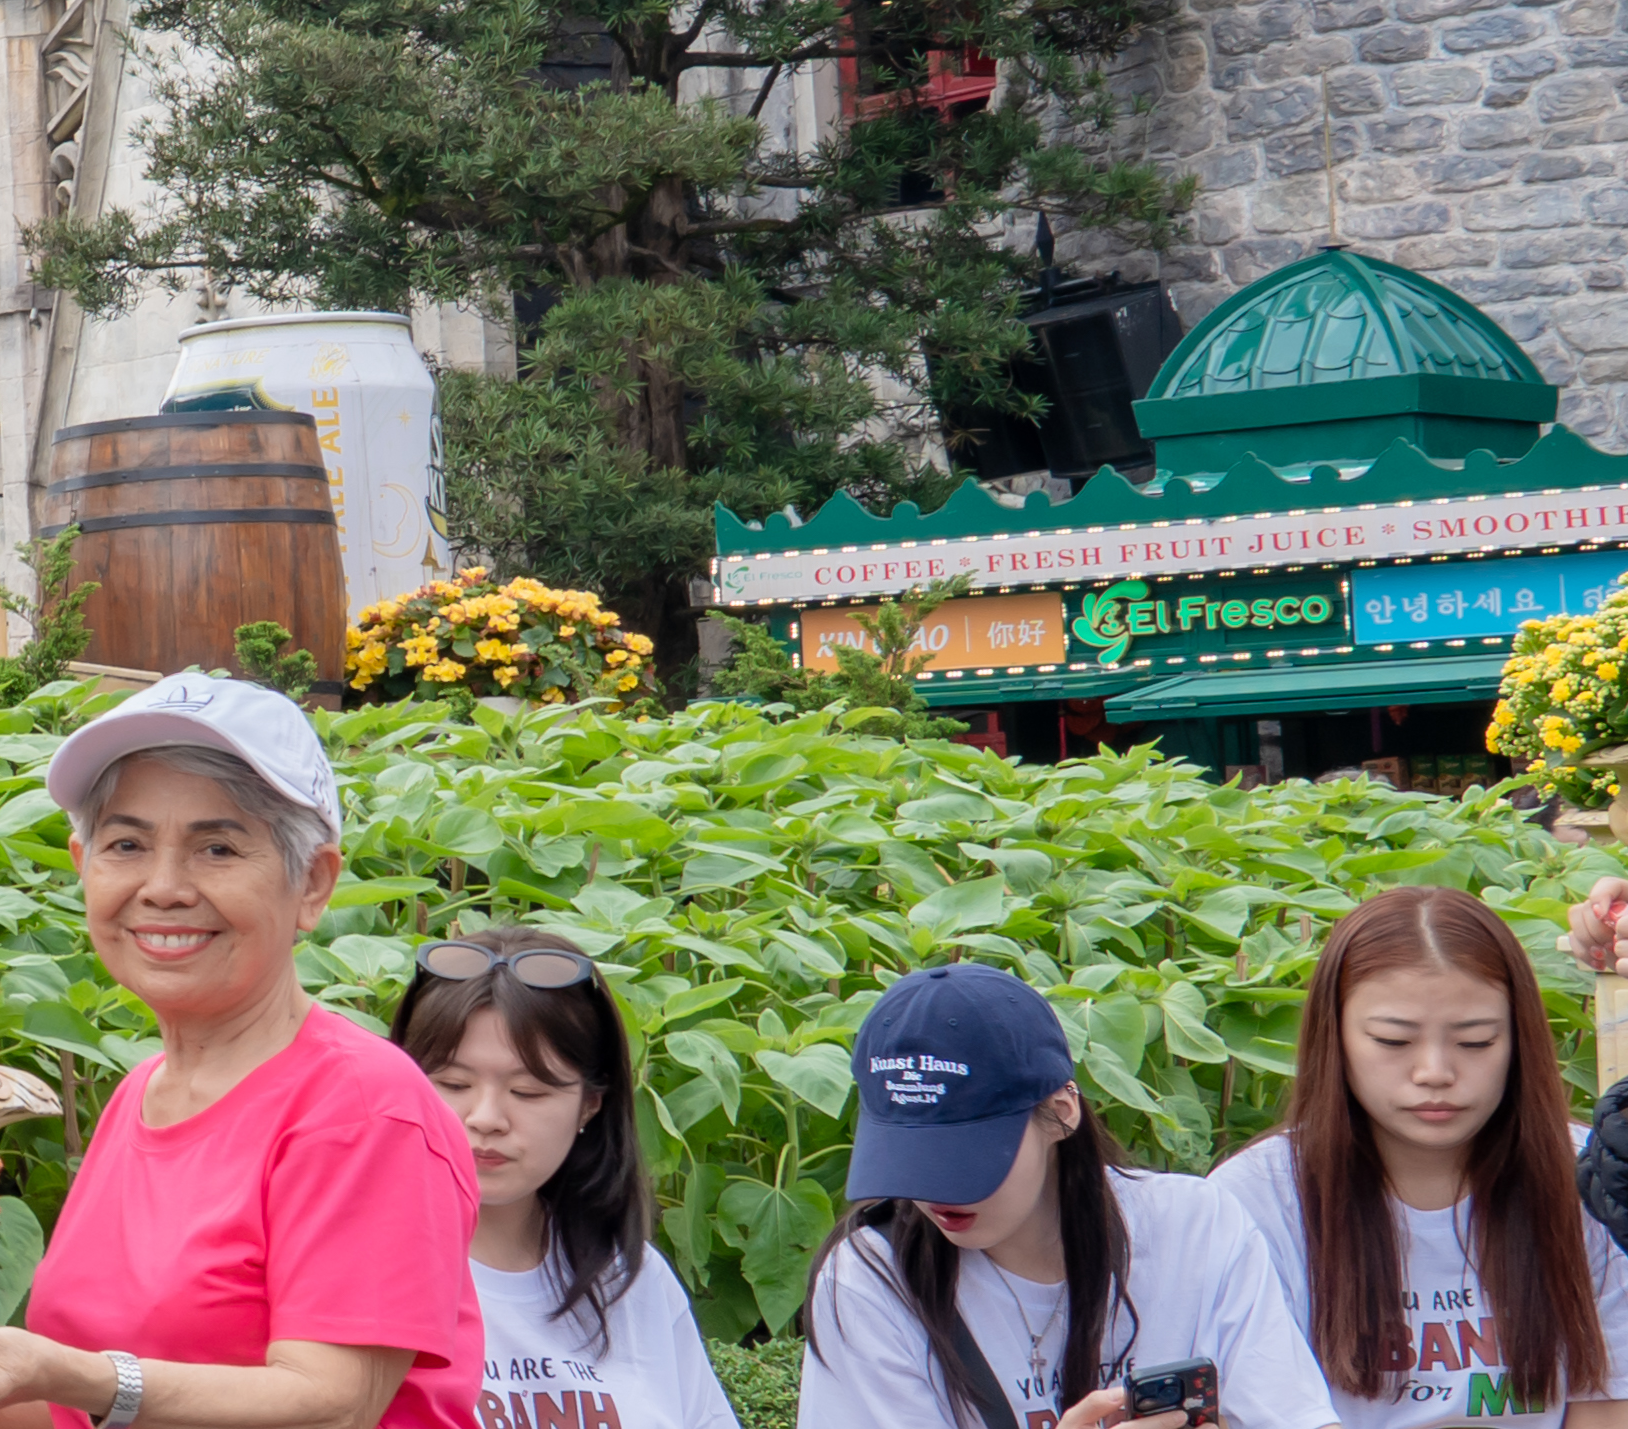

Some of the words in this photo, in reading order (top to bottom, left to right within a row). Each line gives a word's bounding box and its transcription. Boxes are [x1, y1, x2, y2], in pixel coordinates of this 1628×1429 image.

[759, 571, 803, 581] Fresco
[814, 558, 945, 586] COFFEE
[986, 546, 1102, 573] FRESH
[1119, 536, 1233, 563] FRUIT
[1249, 525, 1366, 553] JUICE
[1127, 599, 1170, 636] El
[1177, 594, 1331, 632] Fresco
[1364, 586, 1544, 624] 안녕하세요
[987, 619, 1046, 650] 你好
[869, 1055, 915, 1073] Kunst
[919, 1054, 970, 1076] Haus
[1433, 1288, 1475, 1311] ARE
[510, 1357, 556, 1382] ARE
[562, 1359, 604, 1383] THE
[1392, 1379, 1453, 1406] for
